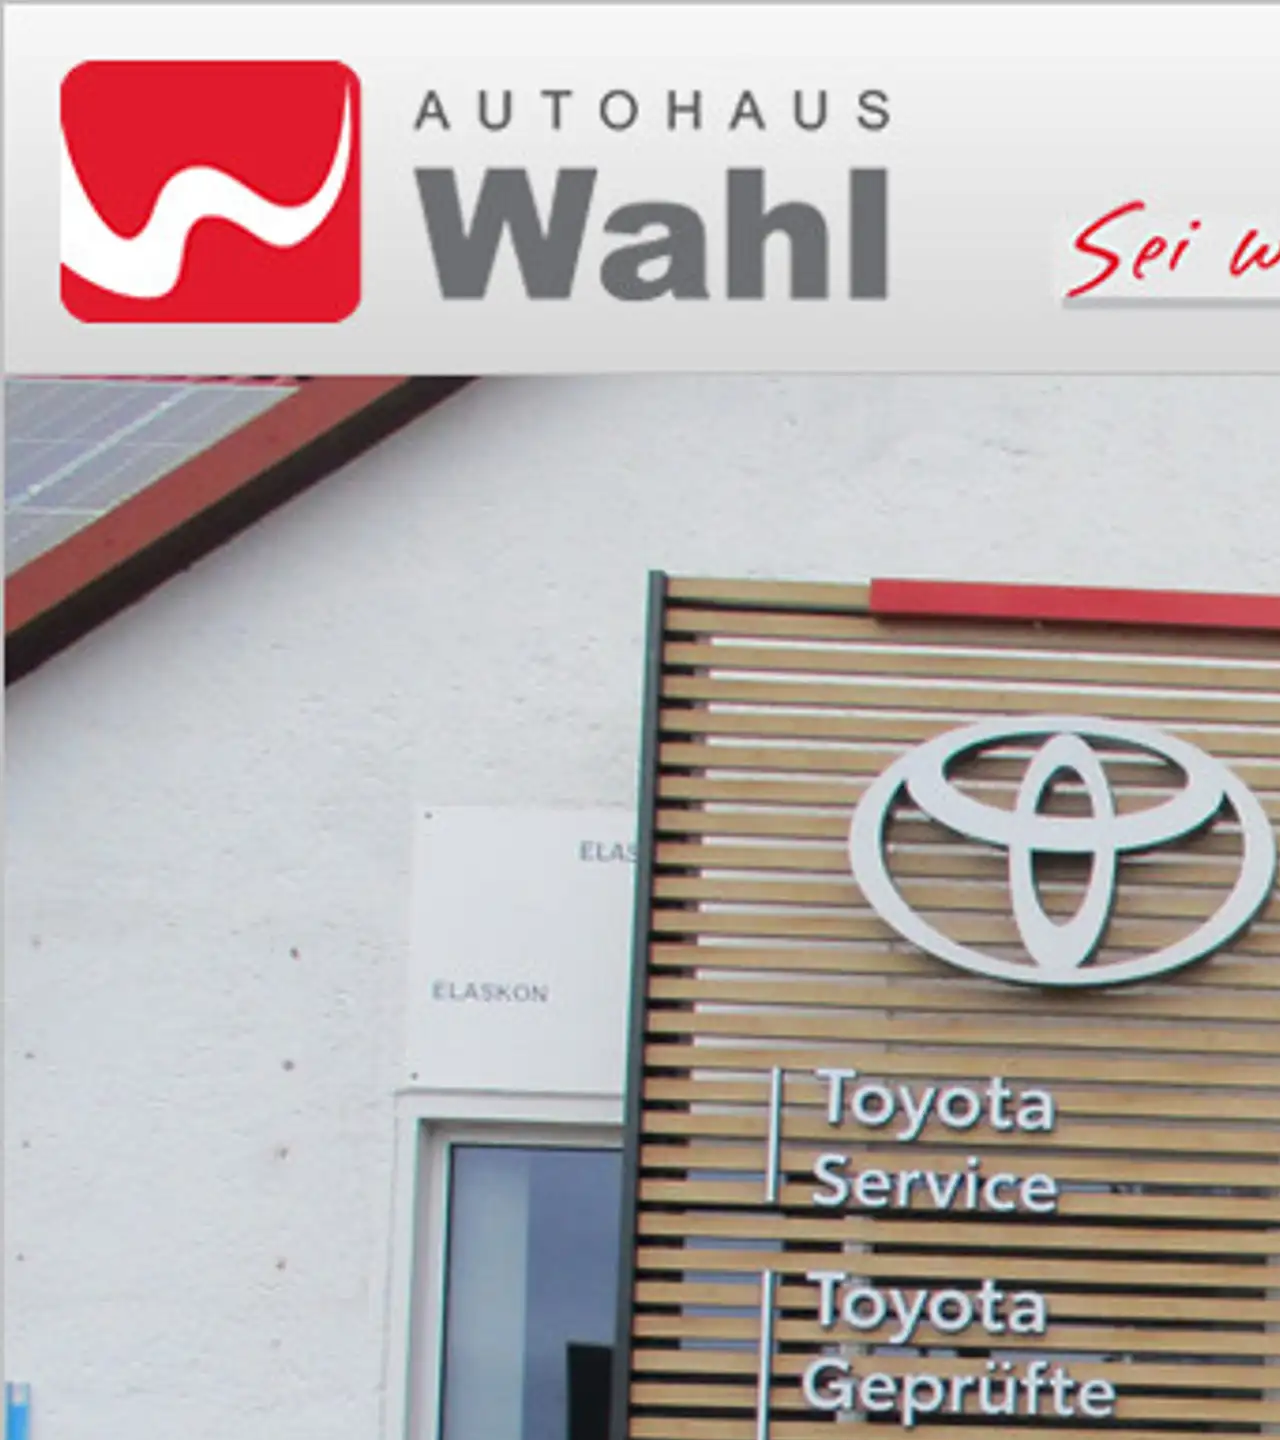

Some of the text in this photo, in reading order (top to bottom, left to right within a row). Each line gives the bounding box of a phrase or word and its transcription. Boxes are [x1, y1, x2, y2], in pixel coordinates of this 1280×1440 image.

[432, 981, 549, 1004] ELASKON
[816, 1068, 1055, 1141] Toyota
[812, 1153, 1058, 1212] Service
[807, 1271, 1046, 1344] Toyota
[802, 1357, 1116, 1427] Geprüfte
